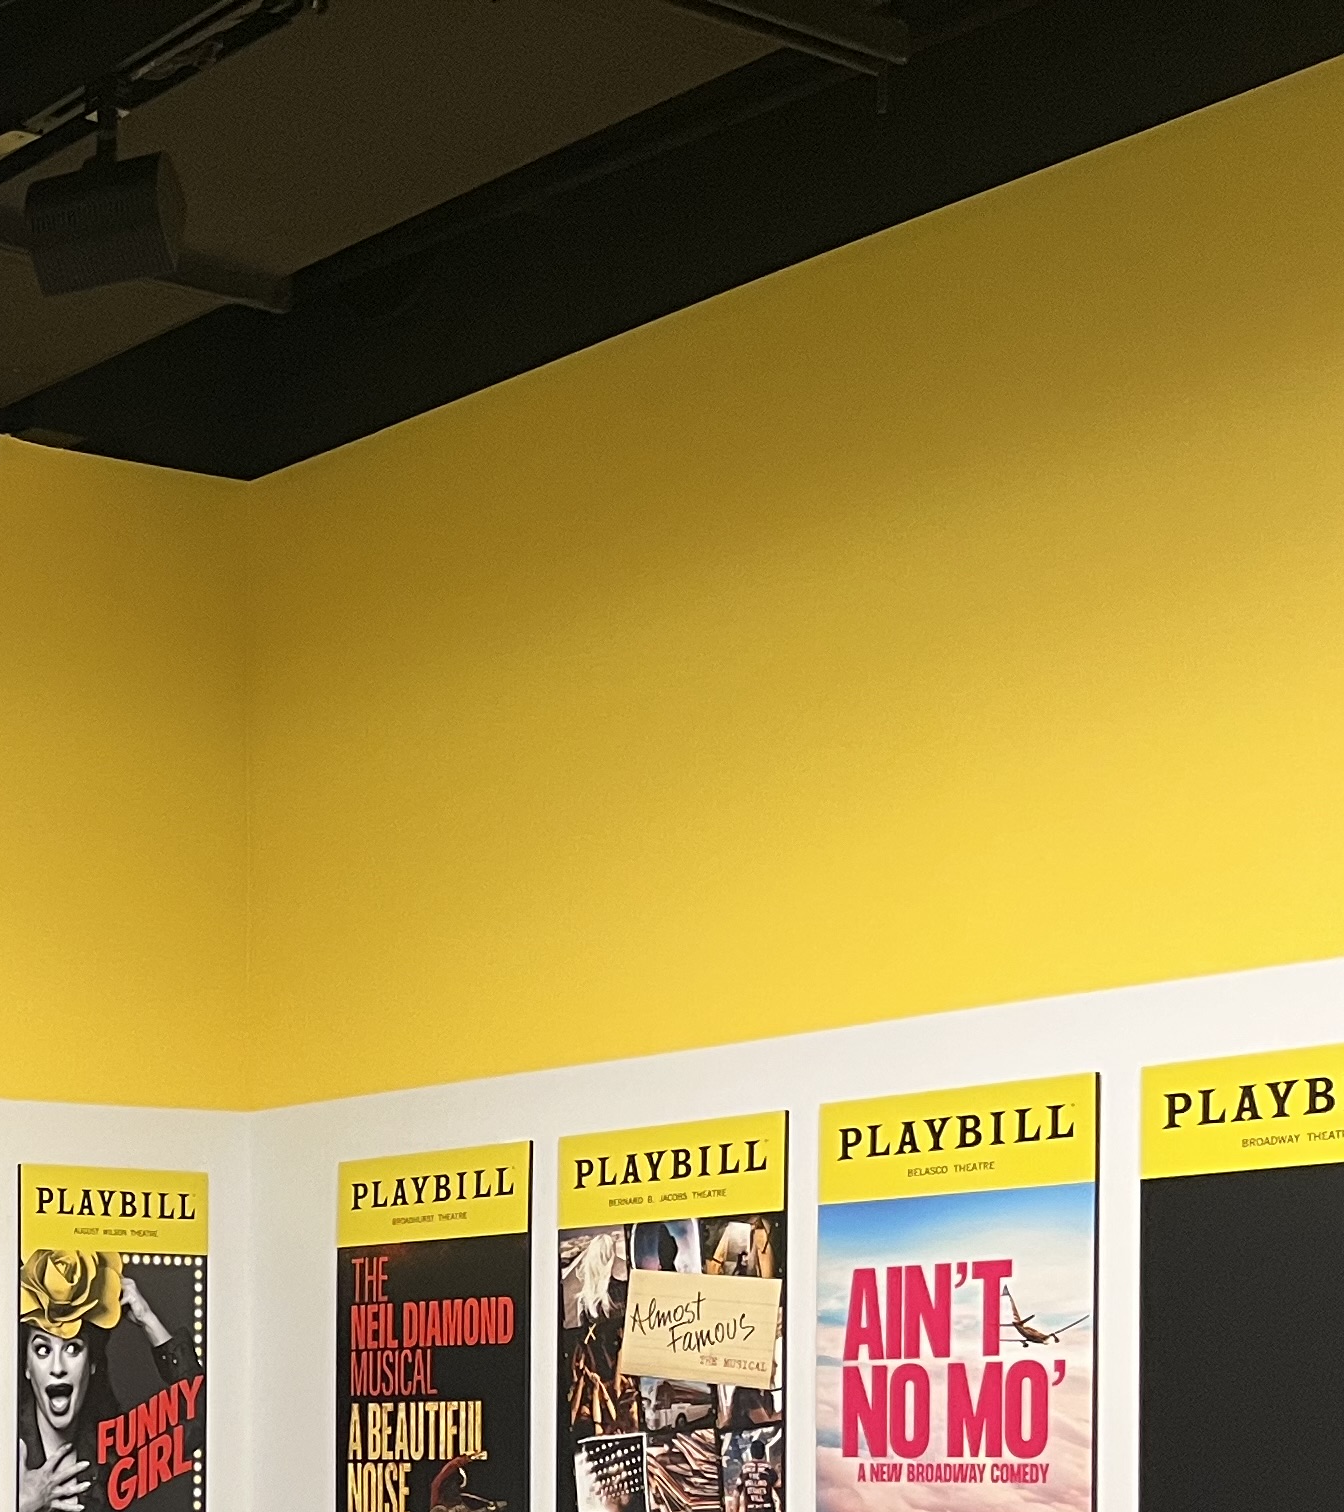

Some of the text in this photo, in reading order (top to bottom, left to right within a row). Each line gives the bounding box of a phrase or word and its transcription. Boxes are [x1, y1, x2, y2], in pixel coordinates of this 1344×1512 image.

[837, 1103, 1074, 1161] PLAYBILL
[1242, 1134, 1300, 1148] BROADWAY
[574, 1139, 767, 1190] PLAYBILL
[908, 1161, 995, 1177] BELASCO THEATRE
[35, 1187, 196, 1220] PLAYBILL
[351, 1166, 514, 1211] PLAYBILL
[609, 1188, 727, 1207] BERNARD B. JACOBS THEATRE
[74, 1227, 100, 1236] AUGUST
[131, 1229, 159, 1238] THEATRE
[438, 1211, 468, 1221] THEATRE
[351, 1256, 389, 1302] THE
[350, 1296, 514, 1350] NEIL DIAMOND
[630, 1291, 706, 1336] Almost
[843, 1259, 1012, 1361] AIN'T
[667, 1313, 755, 1353] Famous
[350, 1349, 438, 1397] MUSICAL
[699, 1355, 768, 1372] THE MUSICAL
[98, 1375, 204, 1464] FUNNY
[348, 1400, 488, 1461] A BEAUTIFUL
[842, 1359, 1066, 1459] NO MO'
[107, 1425, 192, 1511] GIRL
[857, 1463, 1050, 1484] A NEW BROADWAY COMEDY
